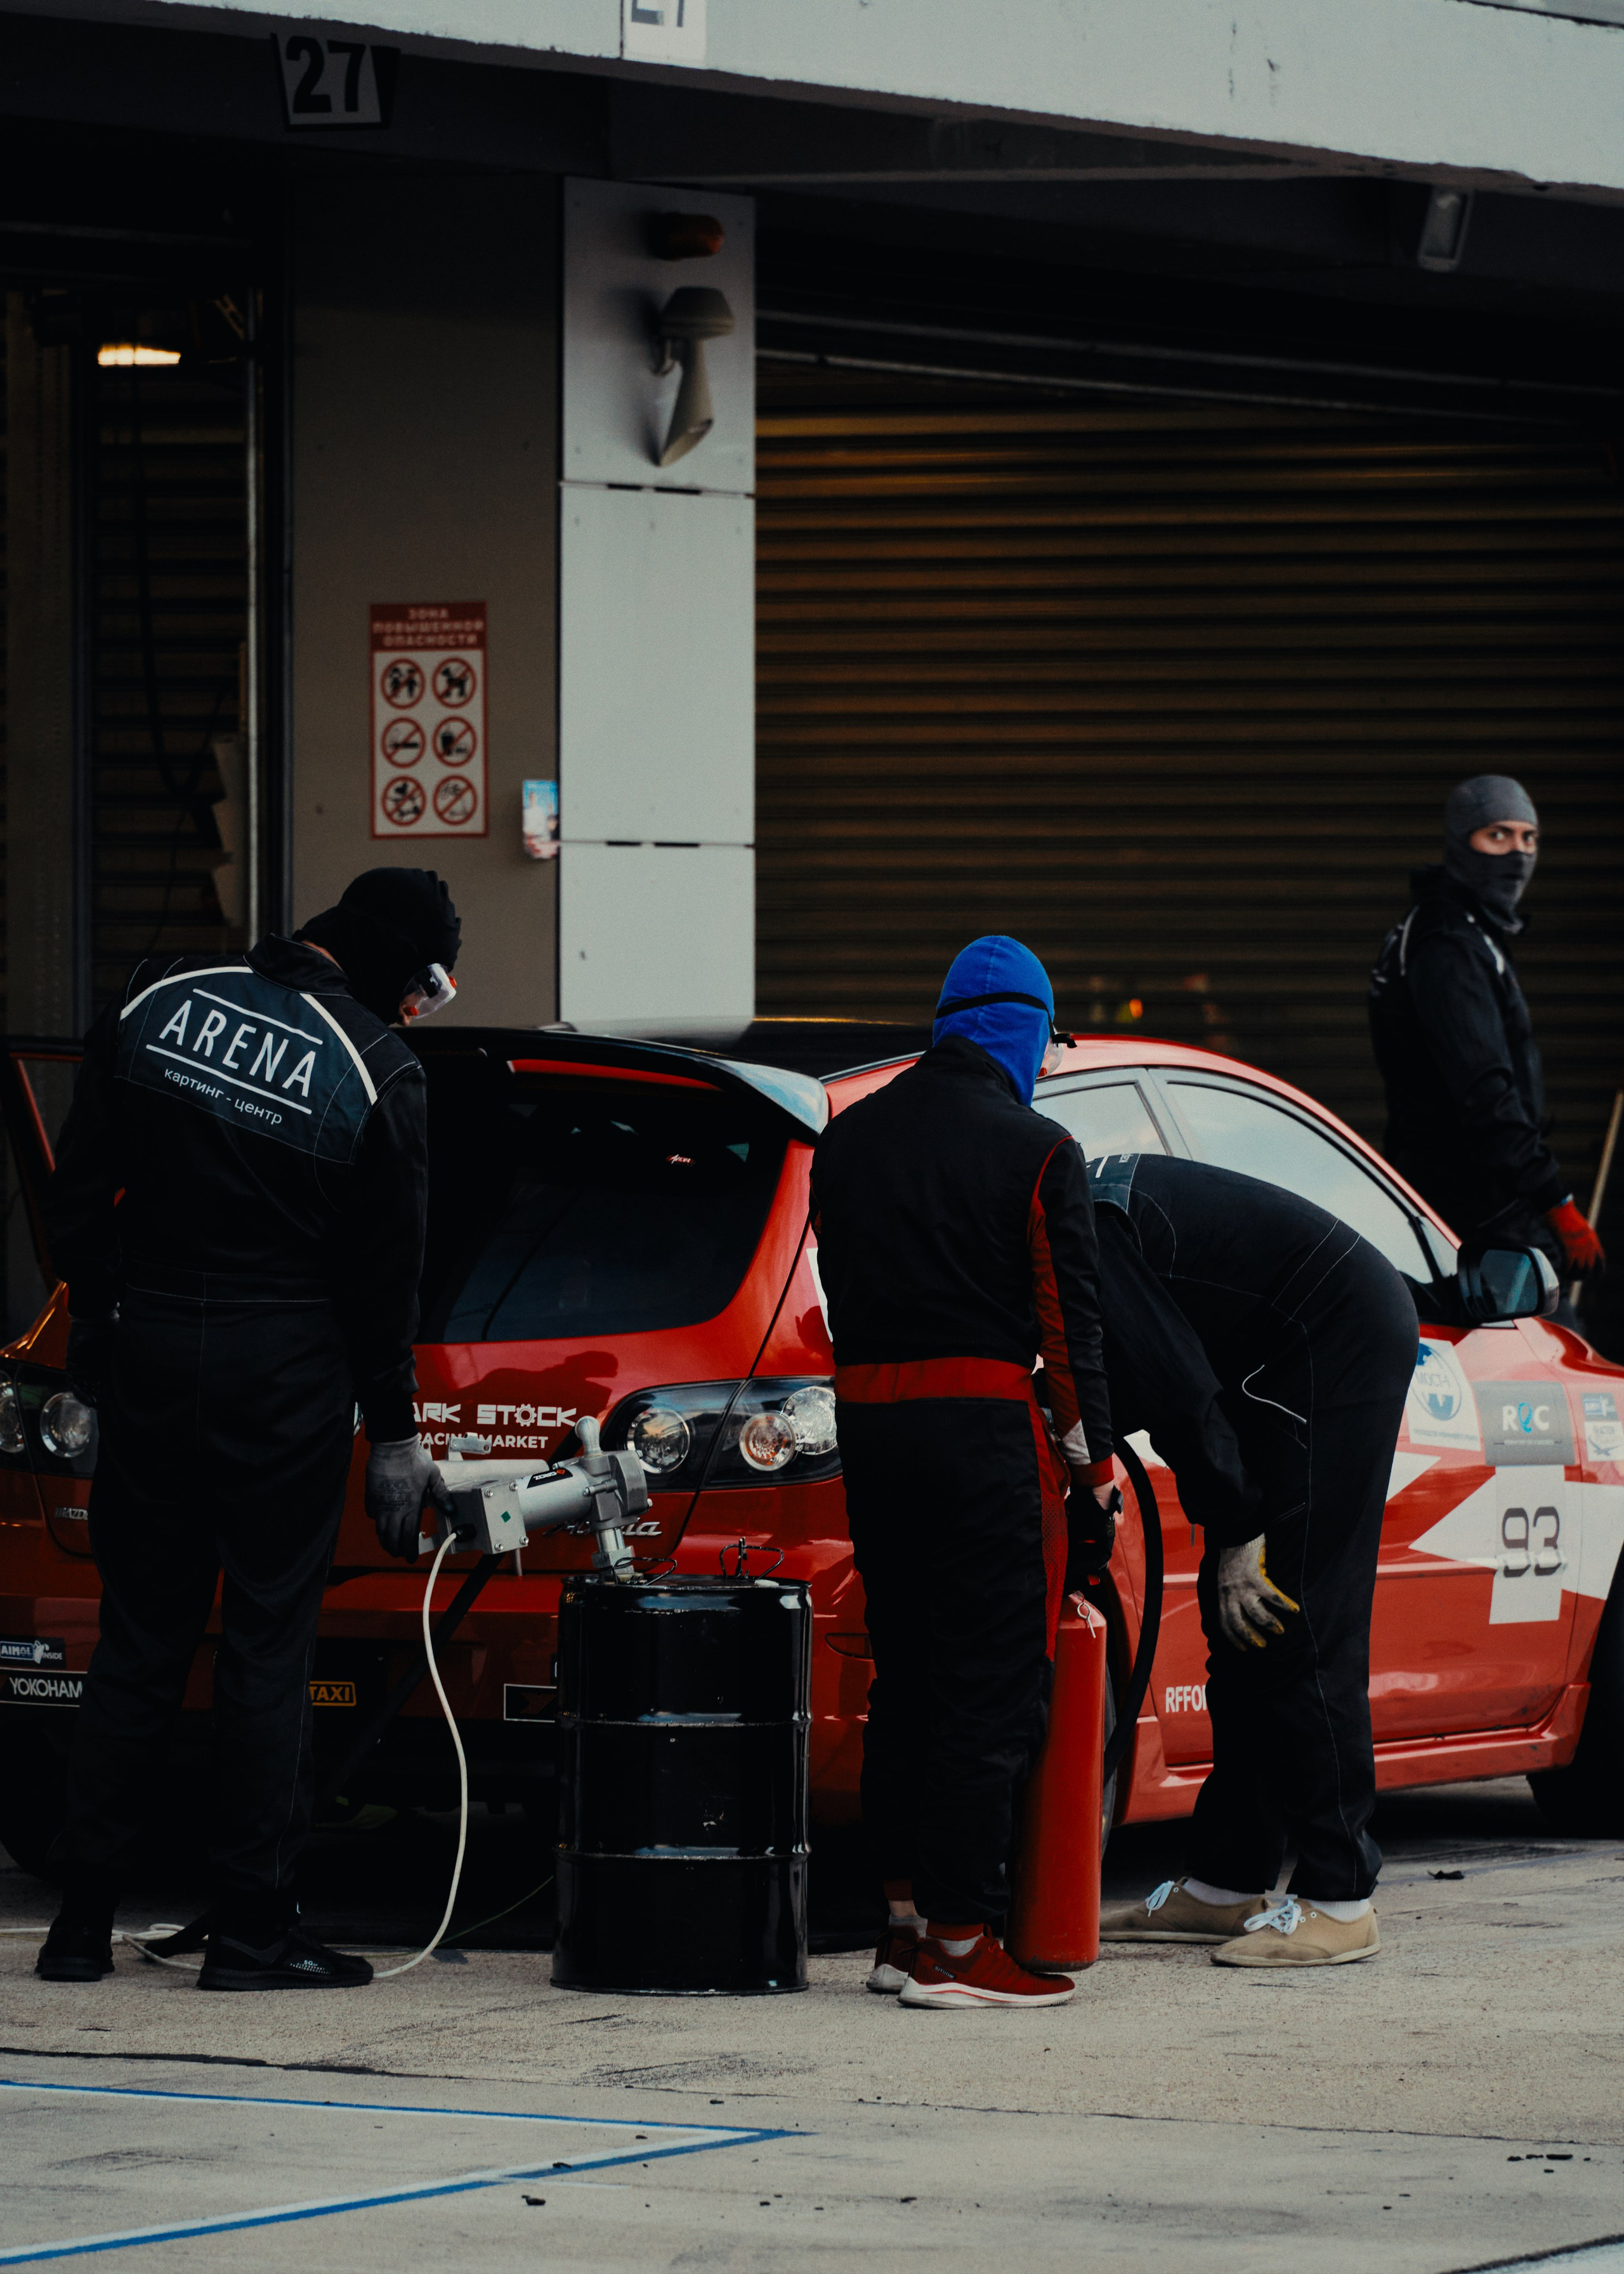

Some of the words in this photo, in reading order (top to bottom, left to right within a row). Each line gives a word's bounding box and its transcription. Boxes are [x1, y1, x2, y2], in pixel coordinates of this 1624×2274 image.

[286, 36, 367, 113] 27
[159, 999, 317, 1098] ARENA
[164, 1068, 225, 1099] картинг
[234, 1098, 283, 1125] центр
[412, 1402, 462, 1423] ARK
[476, 1403, 577, 1427] STOCK
[1502, 1506, 1562, 1578] 93
[9, 1676, 83, 1699] YOKOHAM
[308, 1685, 350, 1701] TAXI
